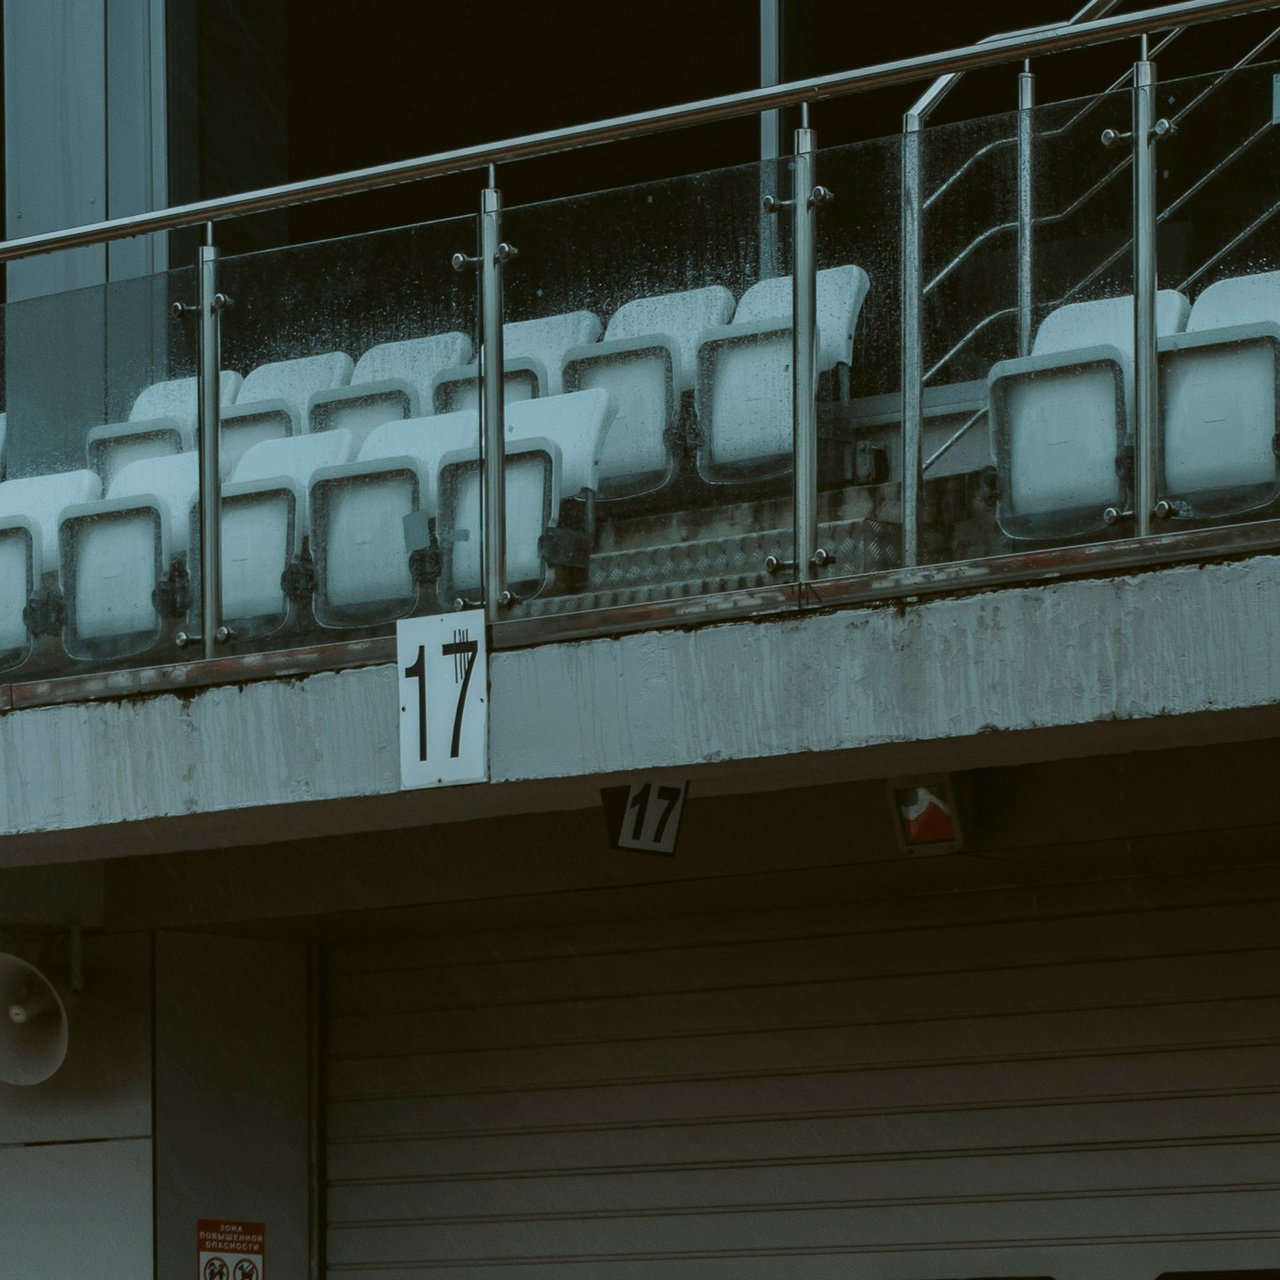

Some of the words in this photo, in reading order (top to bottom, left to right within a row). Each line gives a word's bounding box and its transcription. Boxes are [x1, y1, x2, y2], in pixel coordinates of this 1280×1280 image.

[405, 641, 478, 761] 17
[631, 783, 681, 842] 17
[219, 1224, 242, 1232] ЗОНА
[205, 1241, 259, 1251] ОПАСНОСТИ
